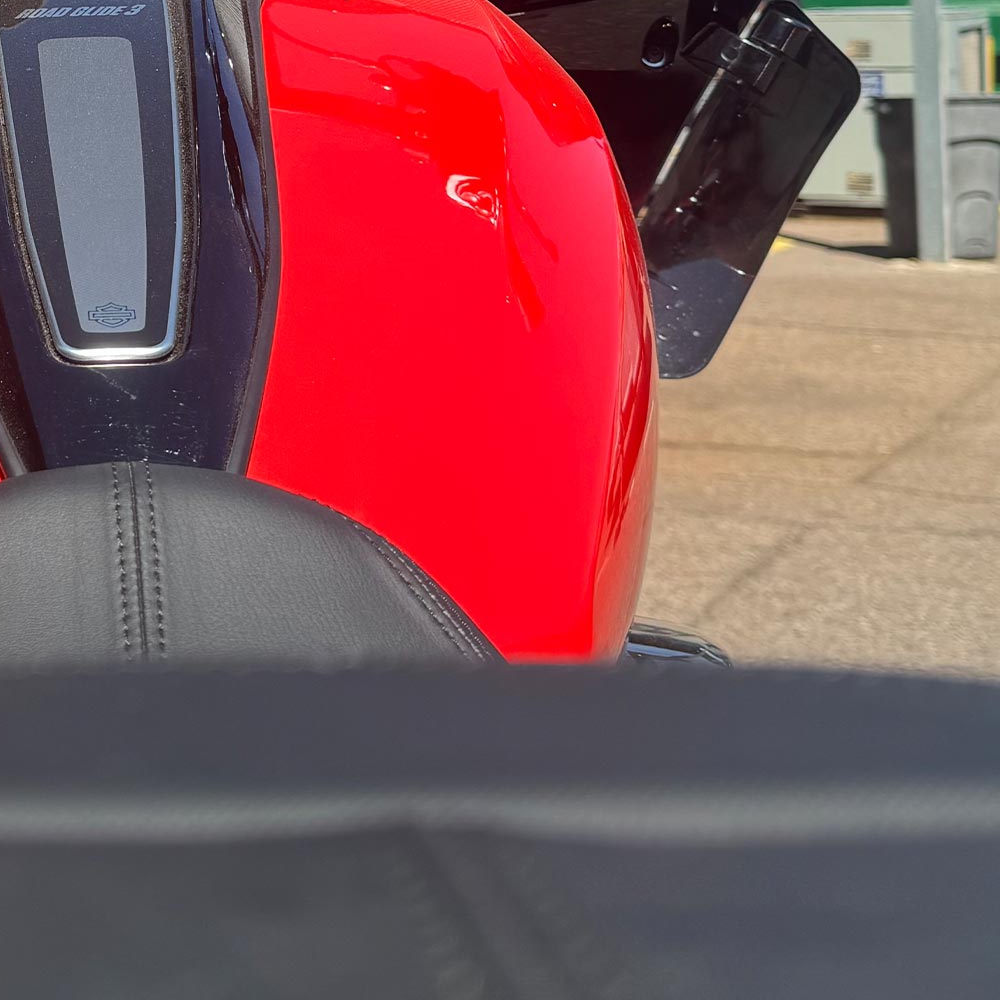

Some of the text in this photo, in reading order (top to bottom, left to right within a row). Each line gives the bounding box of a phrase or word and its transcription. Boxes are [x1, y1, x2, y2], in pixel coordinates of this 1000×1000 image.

[14, 4, 146, 20] ROAD GLIDE 3
